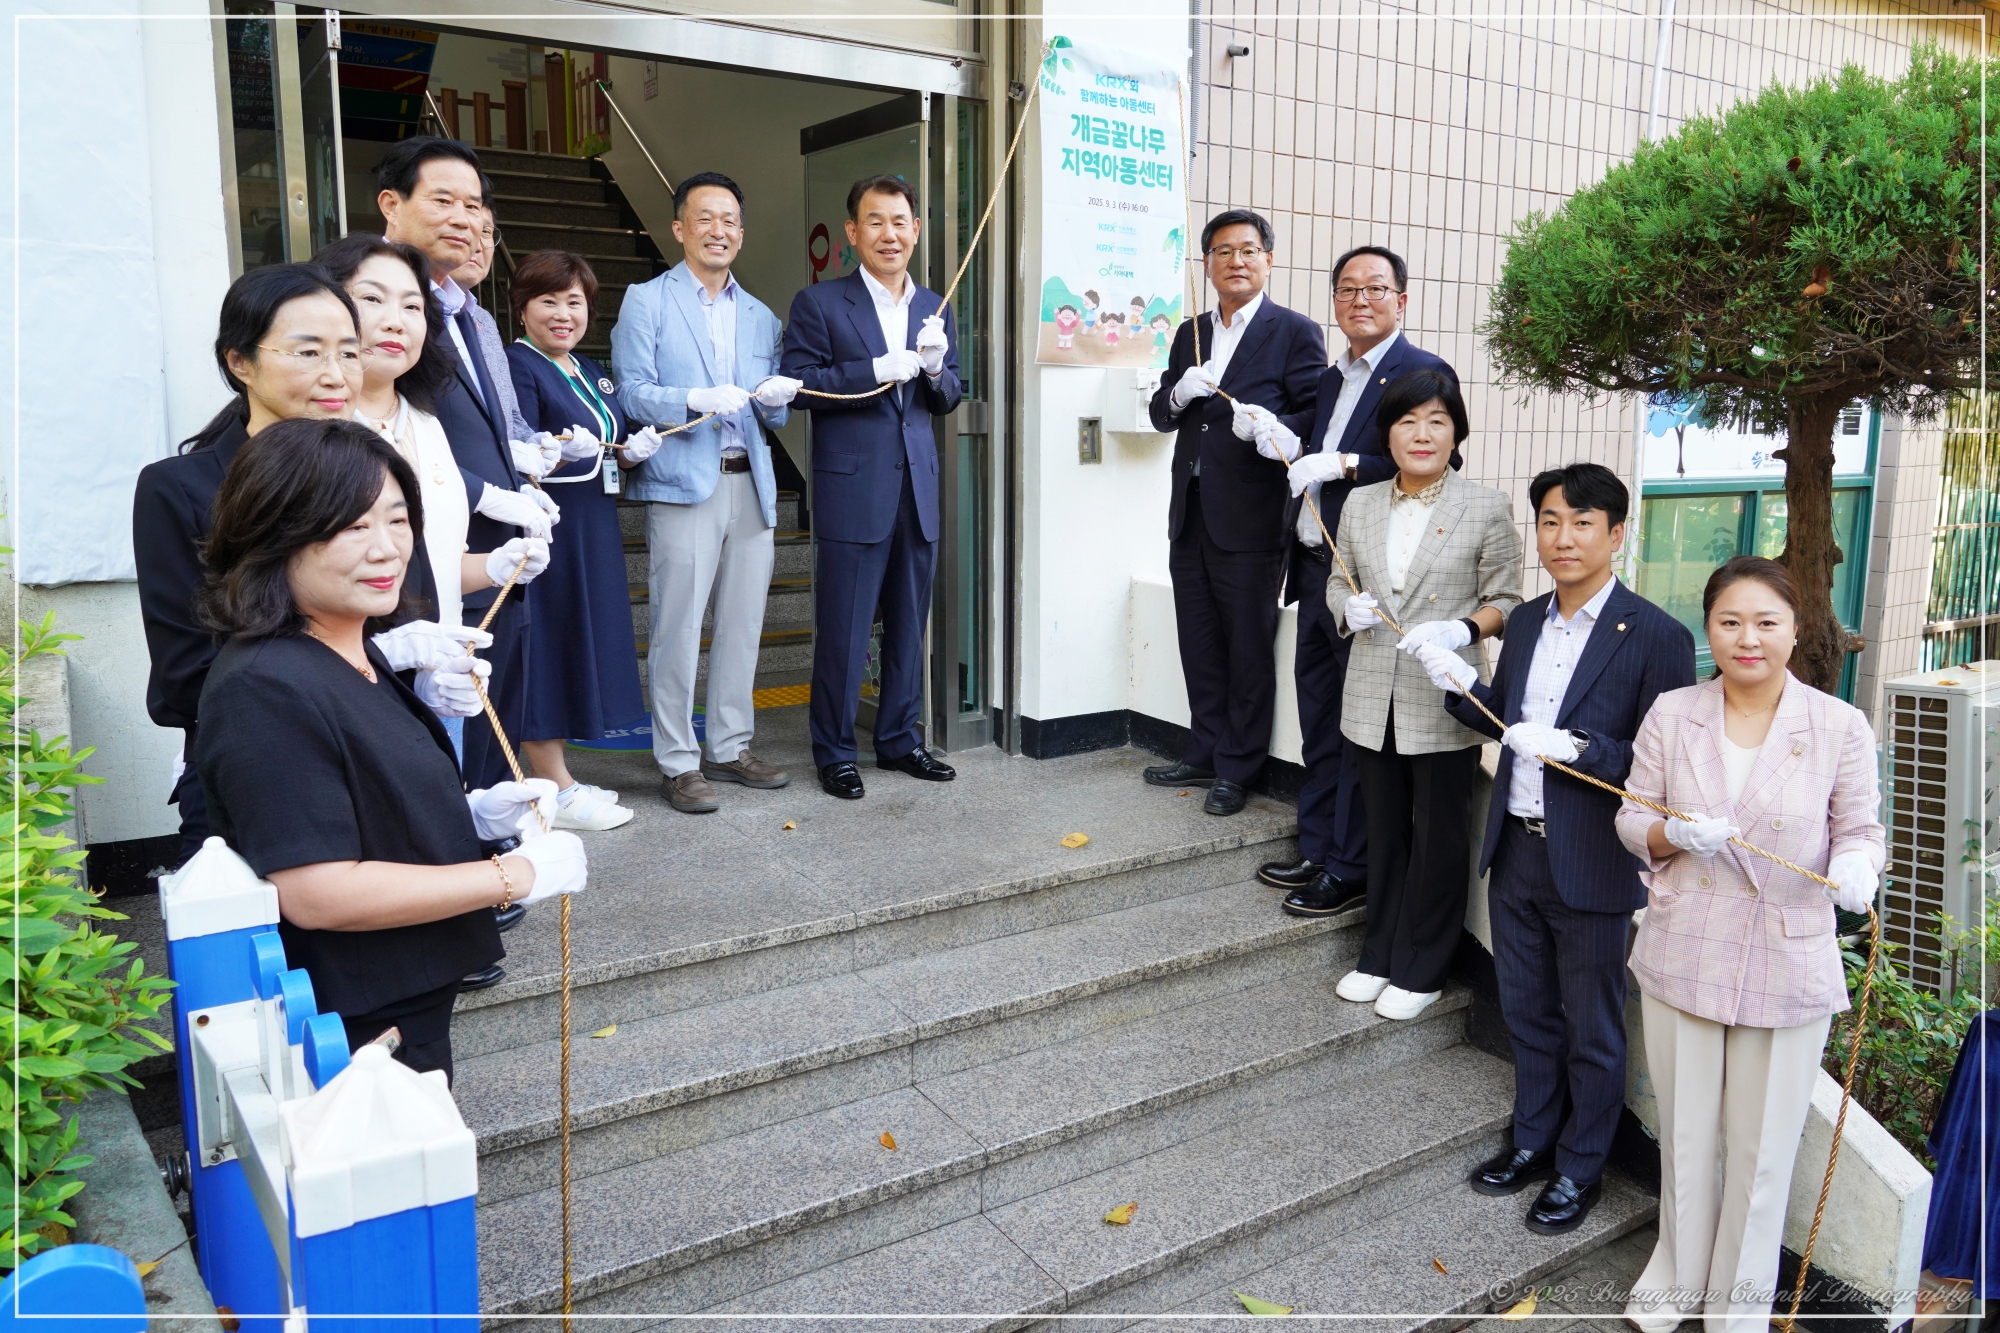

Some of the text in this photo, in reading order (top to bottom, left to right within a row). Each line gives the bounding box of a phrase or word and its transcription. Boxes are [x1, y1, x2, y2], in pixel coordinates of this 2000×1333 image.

[354, 22, 417, 39] 환영합니다
[1080, 88, 1156, 115] 함께하는 아동센터
[1071, 114, 1166, 155] 개금꿈나무
[1061, 147, 1173, 191] 지역아동센터
[1088, 196, 1149, 213] 2025. 9. 3. (수) 16:00
[1098, 223, 1116, 233] KRX
[1096, 243, 1114, 253] KRX
